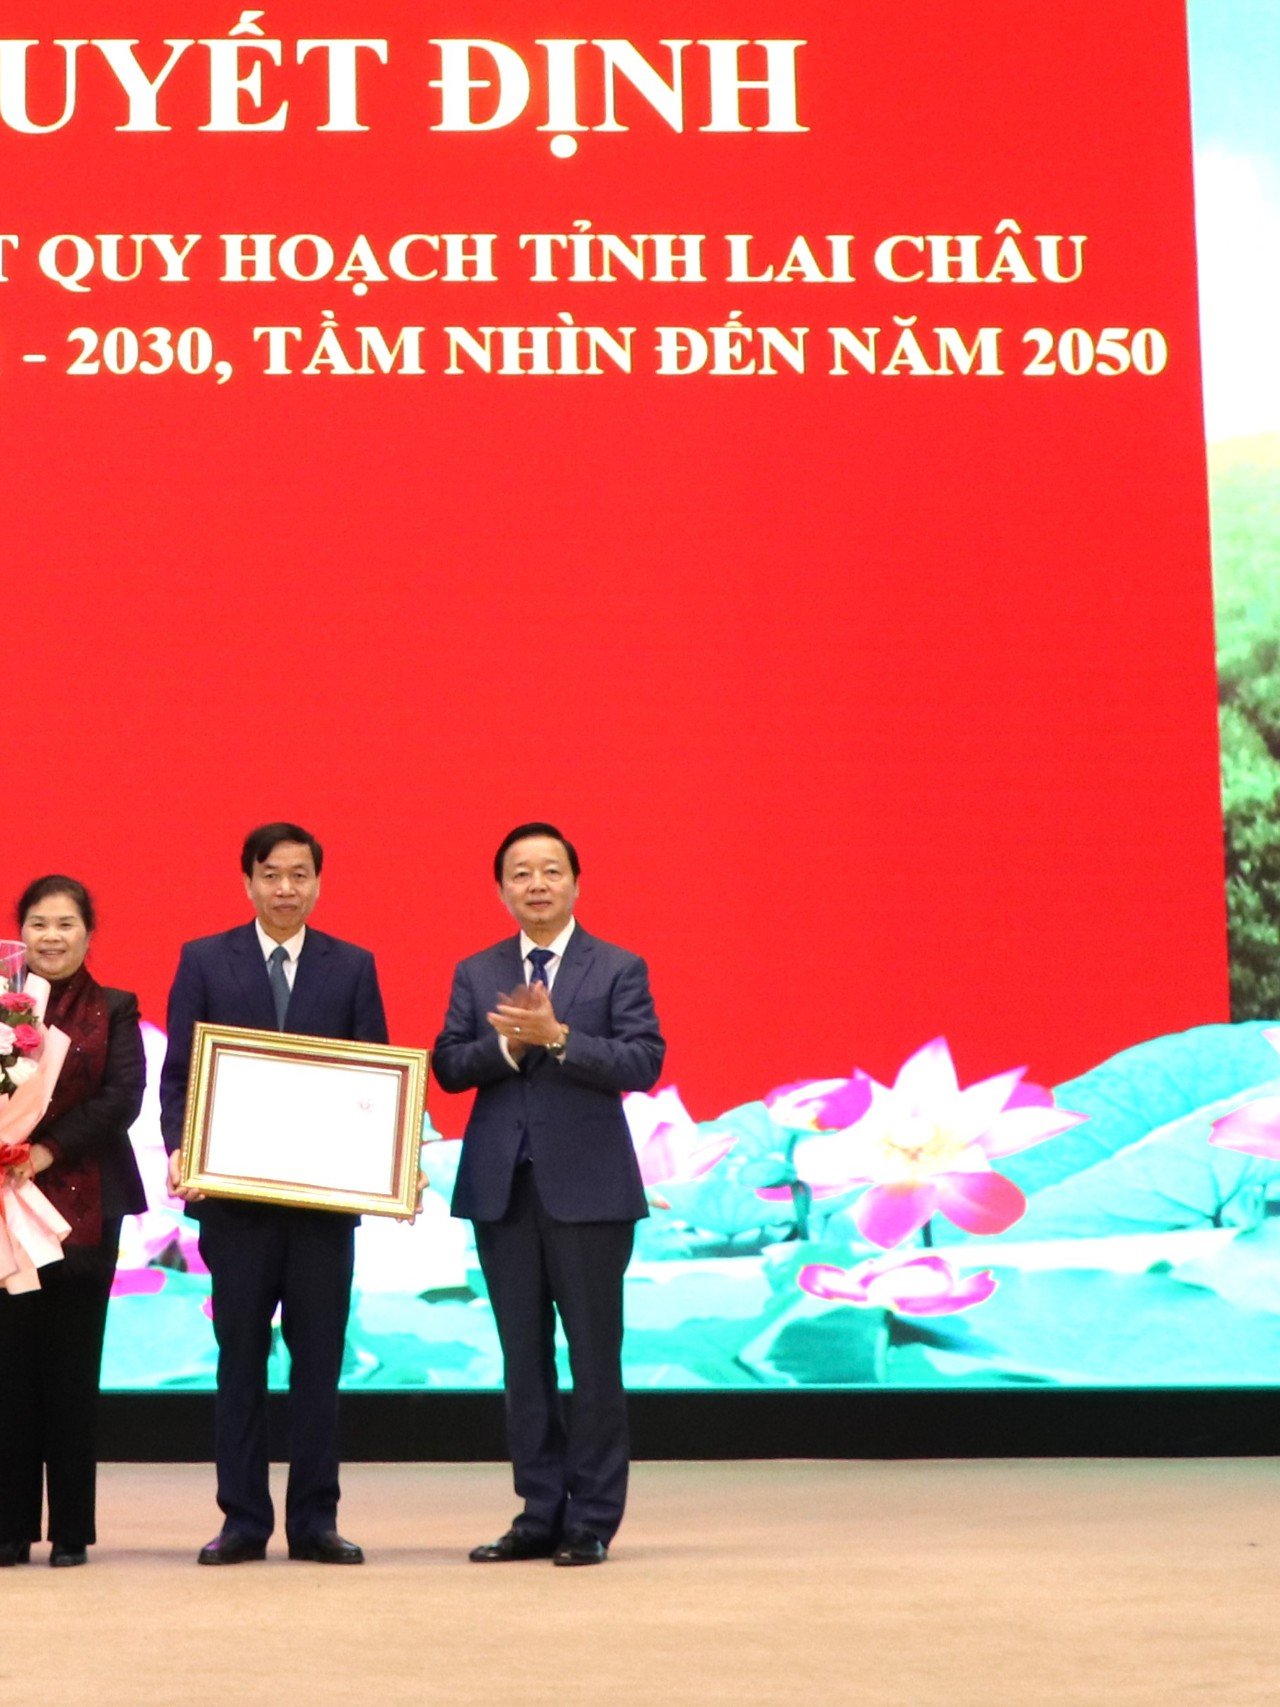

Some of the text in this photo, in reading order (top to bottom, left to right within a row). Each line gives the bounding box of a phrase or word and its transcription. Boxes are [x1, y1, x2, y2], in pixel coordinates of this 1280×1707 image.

[428, 38, 810, 159] ĐỊNH
[38, 233, 202, 293] QUY
[219, 233, 498, 297] HOẠCH
[518, 219, 707, 283] TỈNH
[724, 234, 856, 283] LAI
[873, 218, 1087, 284] CHÂU
[22, 354, 47, 363] -
[66, 326, 233, 385] 2030,
[253, 309, 426, 375] TẦM
[443, 311, 637, 376] NHÌN
[654, 310, 810, 376] ĐẾN
[827, 315, 1004, 376] NĂM
[1022, 327, 1167, 376] 2050
